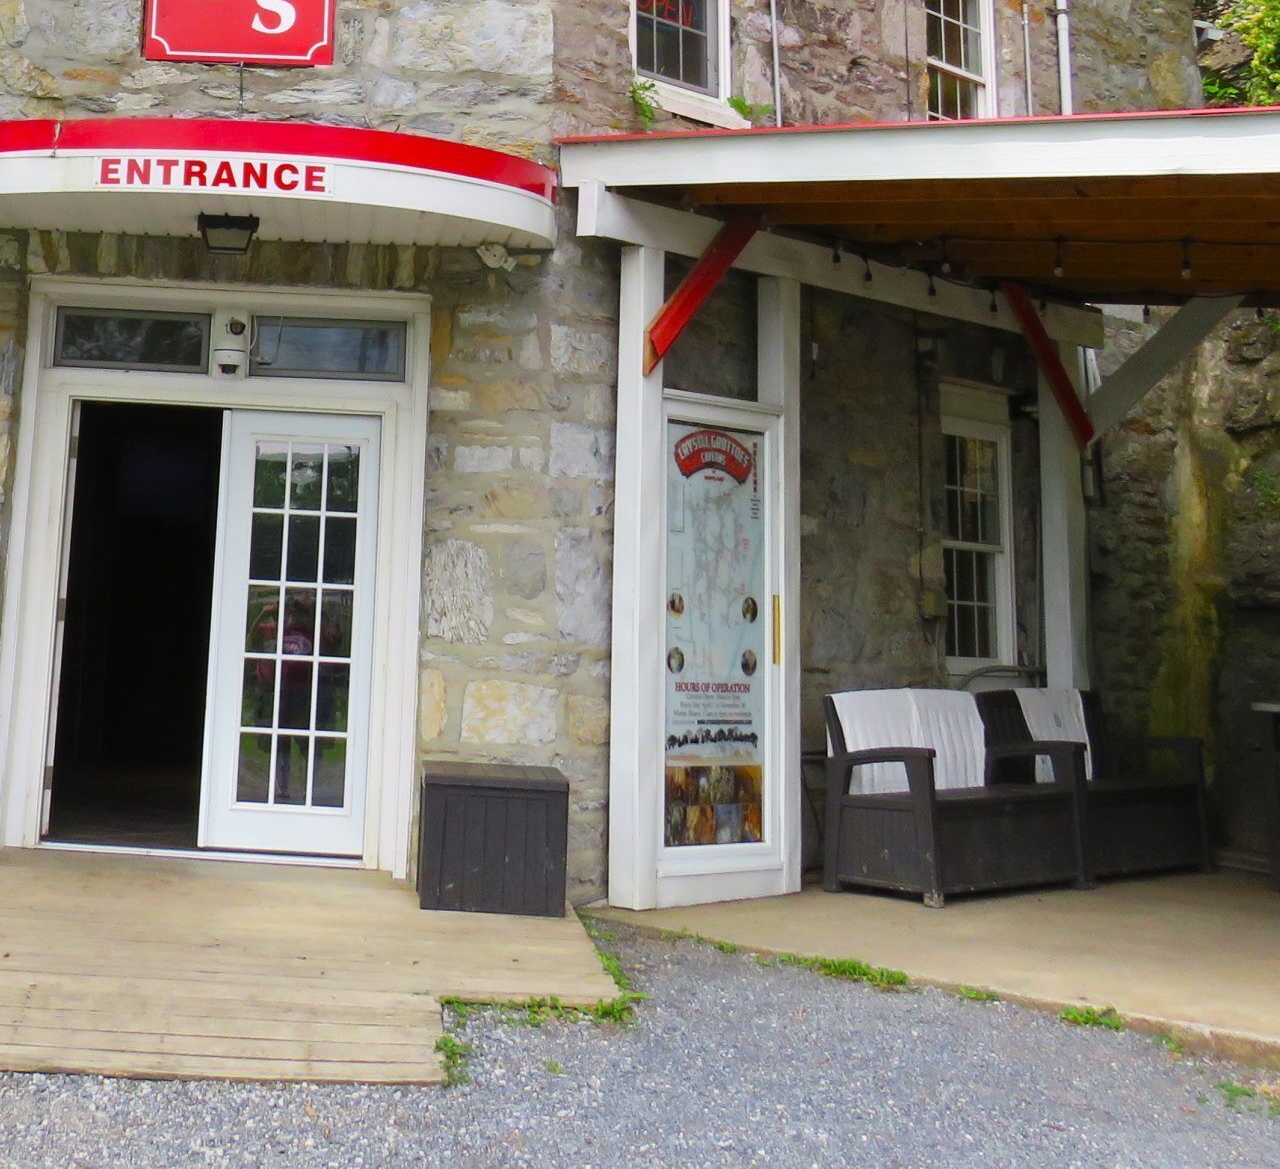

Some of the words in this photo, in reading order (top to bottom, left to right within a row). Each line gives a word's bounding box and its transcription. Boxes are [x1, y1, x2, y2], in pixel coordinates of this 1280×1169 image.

[100, 157, 326, 193] ENTRANCE
[675, 682, 700, 692] HOURS
[702, 682, 711, 692] OF
[712, 682, 750, 693] OPERATION
